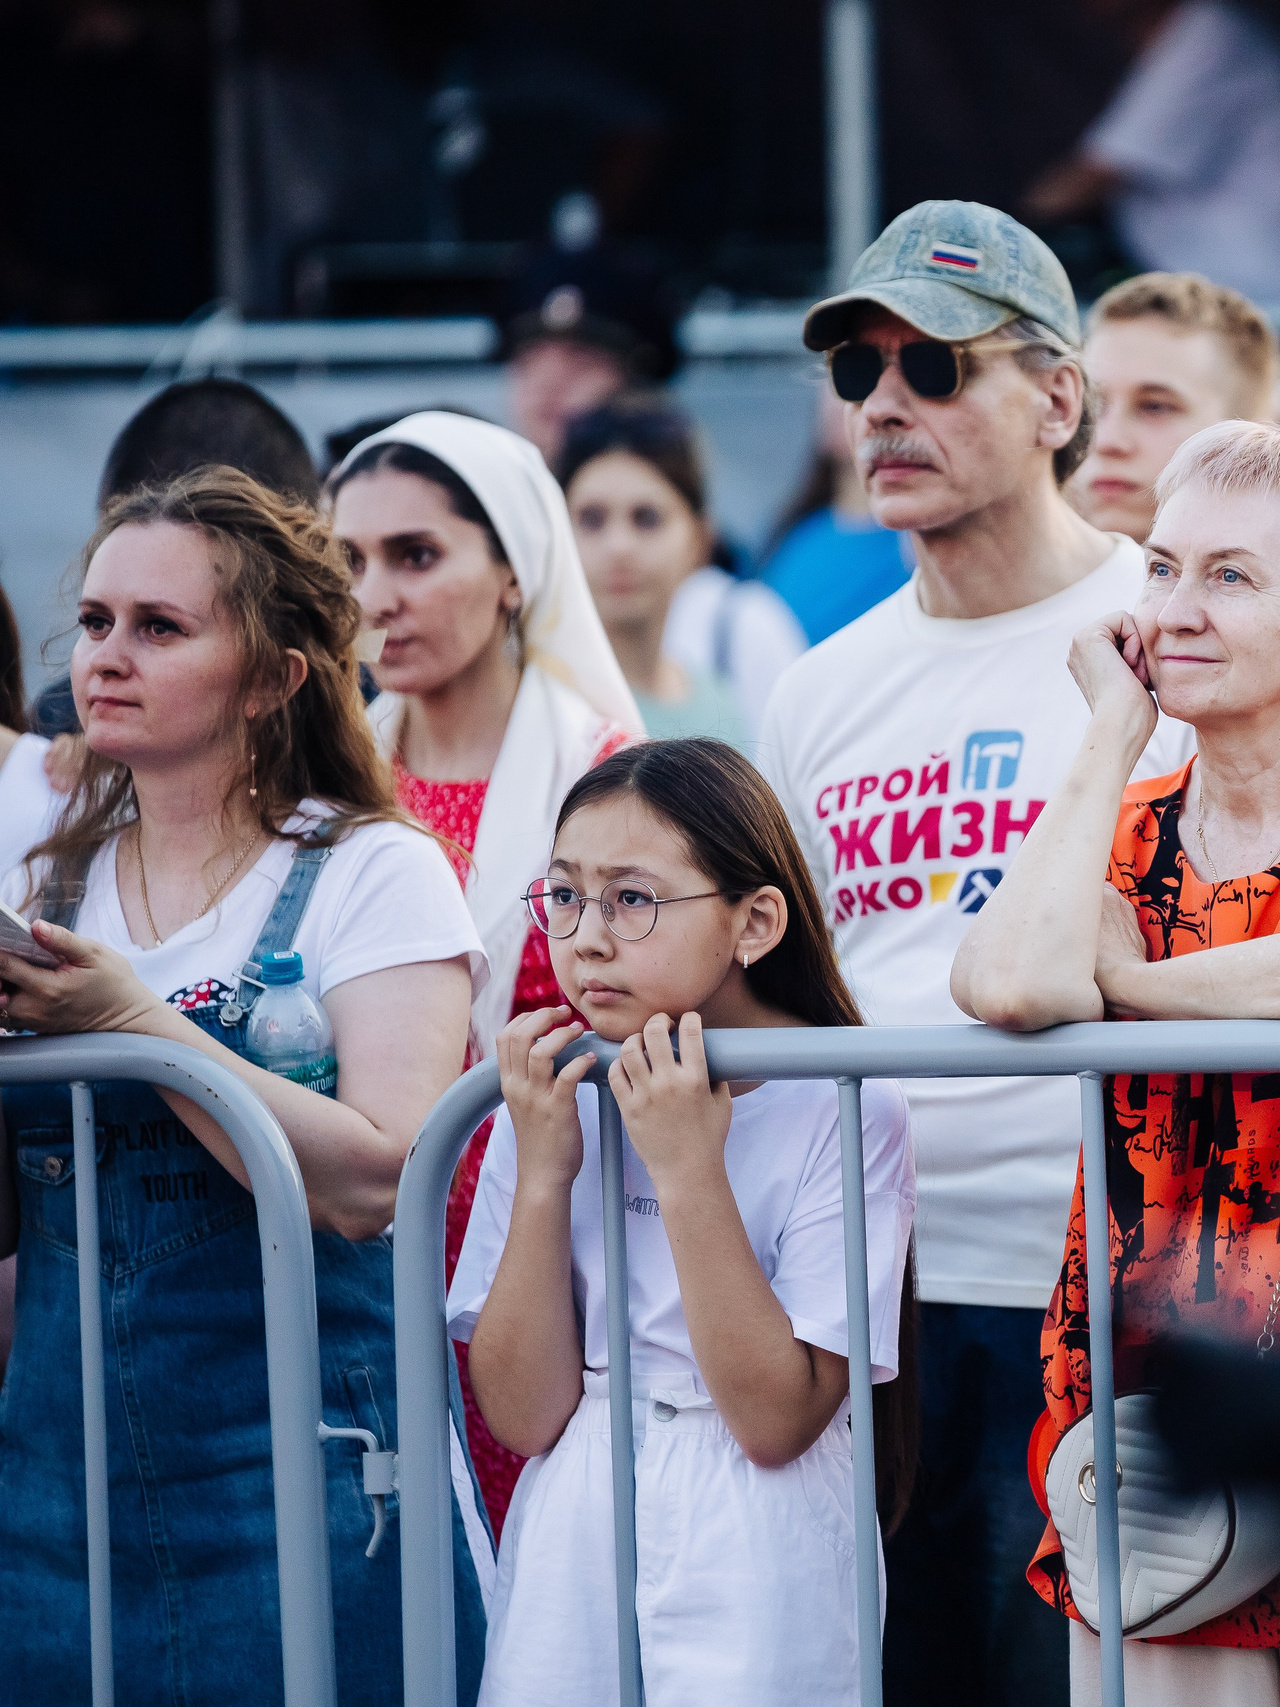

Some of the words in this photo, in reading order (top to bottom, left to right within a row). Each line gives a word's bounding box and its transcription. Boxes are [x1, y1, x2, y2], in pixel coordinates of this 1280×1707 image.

[815, 751, 950, 820] СТРОЙ
[828, 799, 1048, 876] ЖИЗН
[141, 1170, 209, 1203] YOUTH
